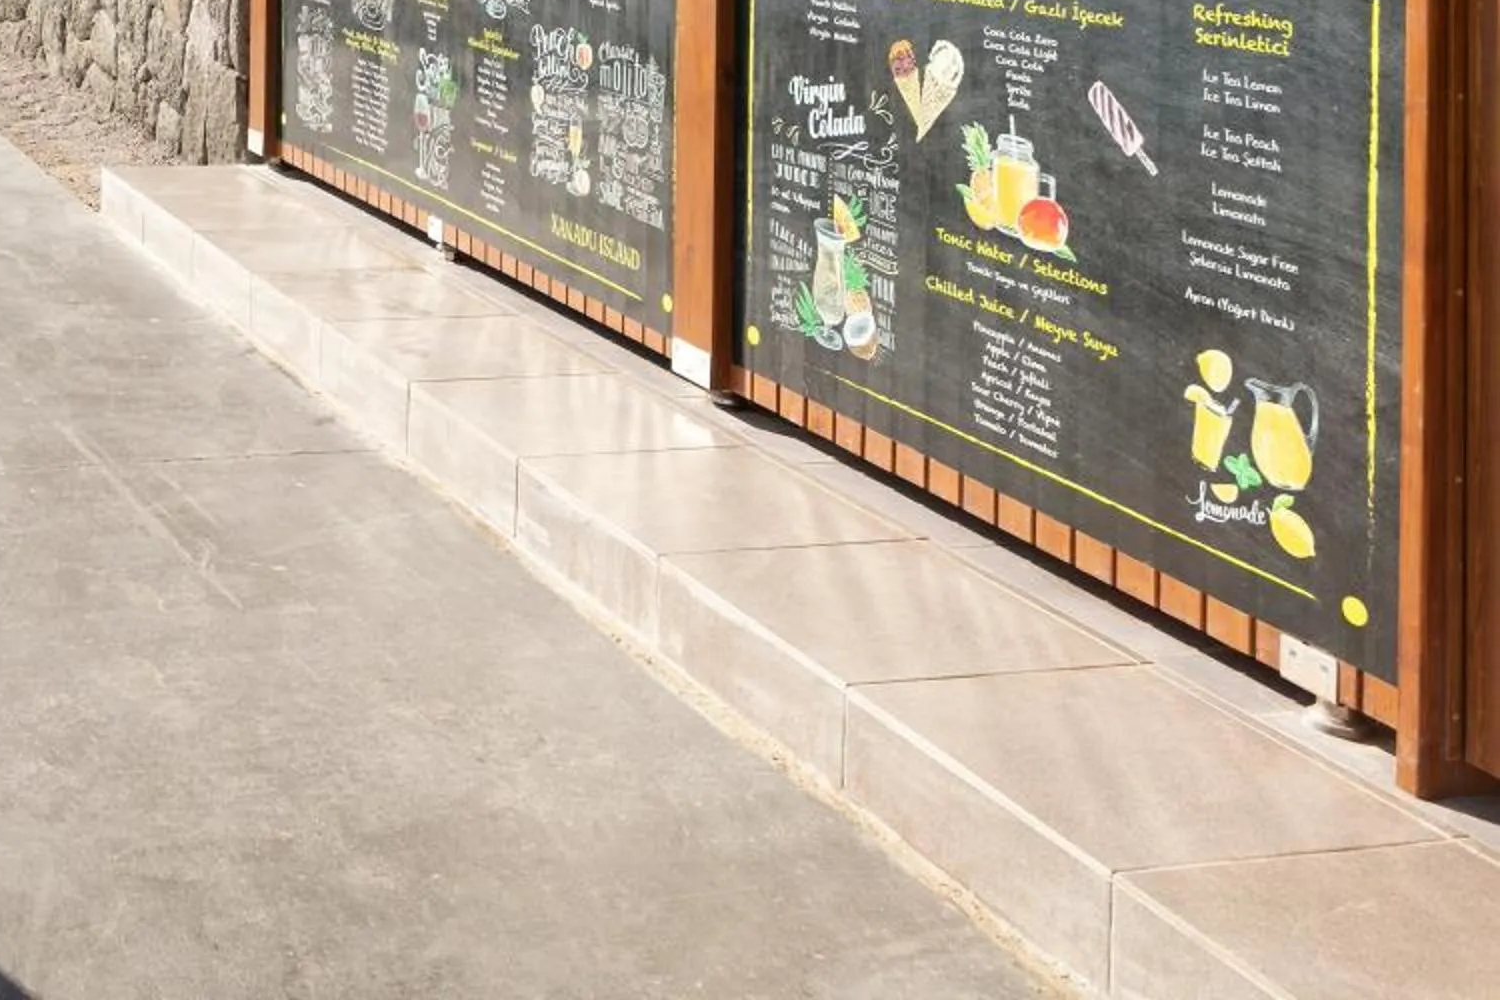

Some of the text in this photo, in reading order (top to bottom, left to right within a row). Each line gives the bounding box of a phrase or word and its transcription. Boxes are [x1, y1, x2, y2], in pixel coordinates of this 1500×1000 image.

[1193, 3, 1293, 38] Refreshing
[1009, 31, 1032, 43] Cola
[1195, 27, 1291, 57] Serinletici
[1008, 44, 1030, 56] Cola
[1033, 47, 1058, 63] Light
[1021, 60, 1044, 73] Cola
[789, 75, 846, 115] Virgin
[1203, 68, 1282, 94] Ice Tea Lemon
[1203, 87, 1281, 113] Ice Tea Limon
[809, 105, 866, 138] Colada
[1203, 124, 1280, 153] Ice Tea Peach
[1201, 143, 1218, 159] Ice
[1221, 147, 1240, 163] Tea
[1211, 181, 1267, 208] Lemonade
[1212, 201, 1267, 226] Limonata
[551, 213, 640, 271] XANADU ISLAND
[1182, 229, 1235, 256] Lemonade
[935, 228, 972, 251] Tonic
[976, 239, 1015, 264] Water
[1033, 259, 1108, 295] Selections
[925, 275, 974, 304] Chilled
[979, 295, 1015, 320] Juice
[1034, 314, 1077, 343] Meyve
[1185, 480, 1271, 526] Lemonade
